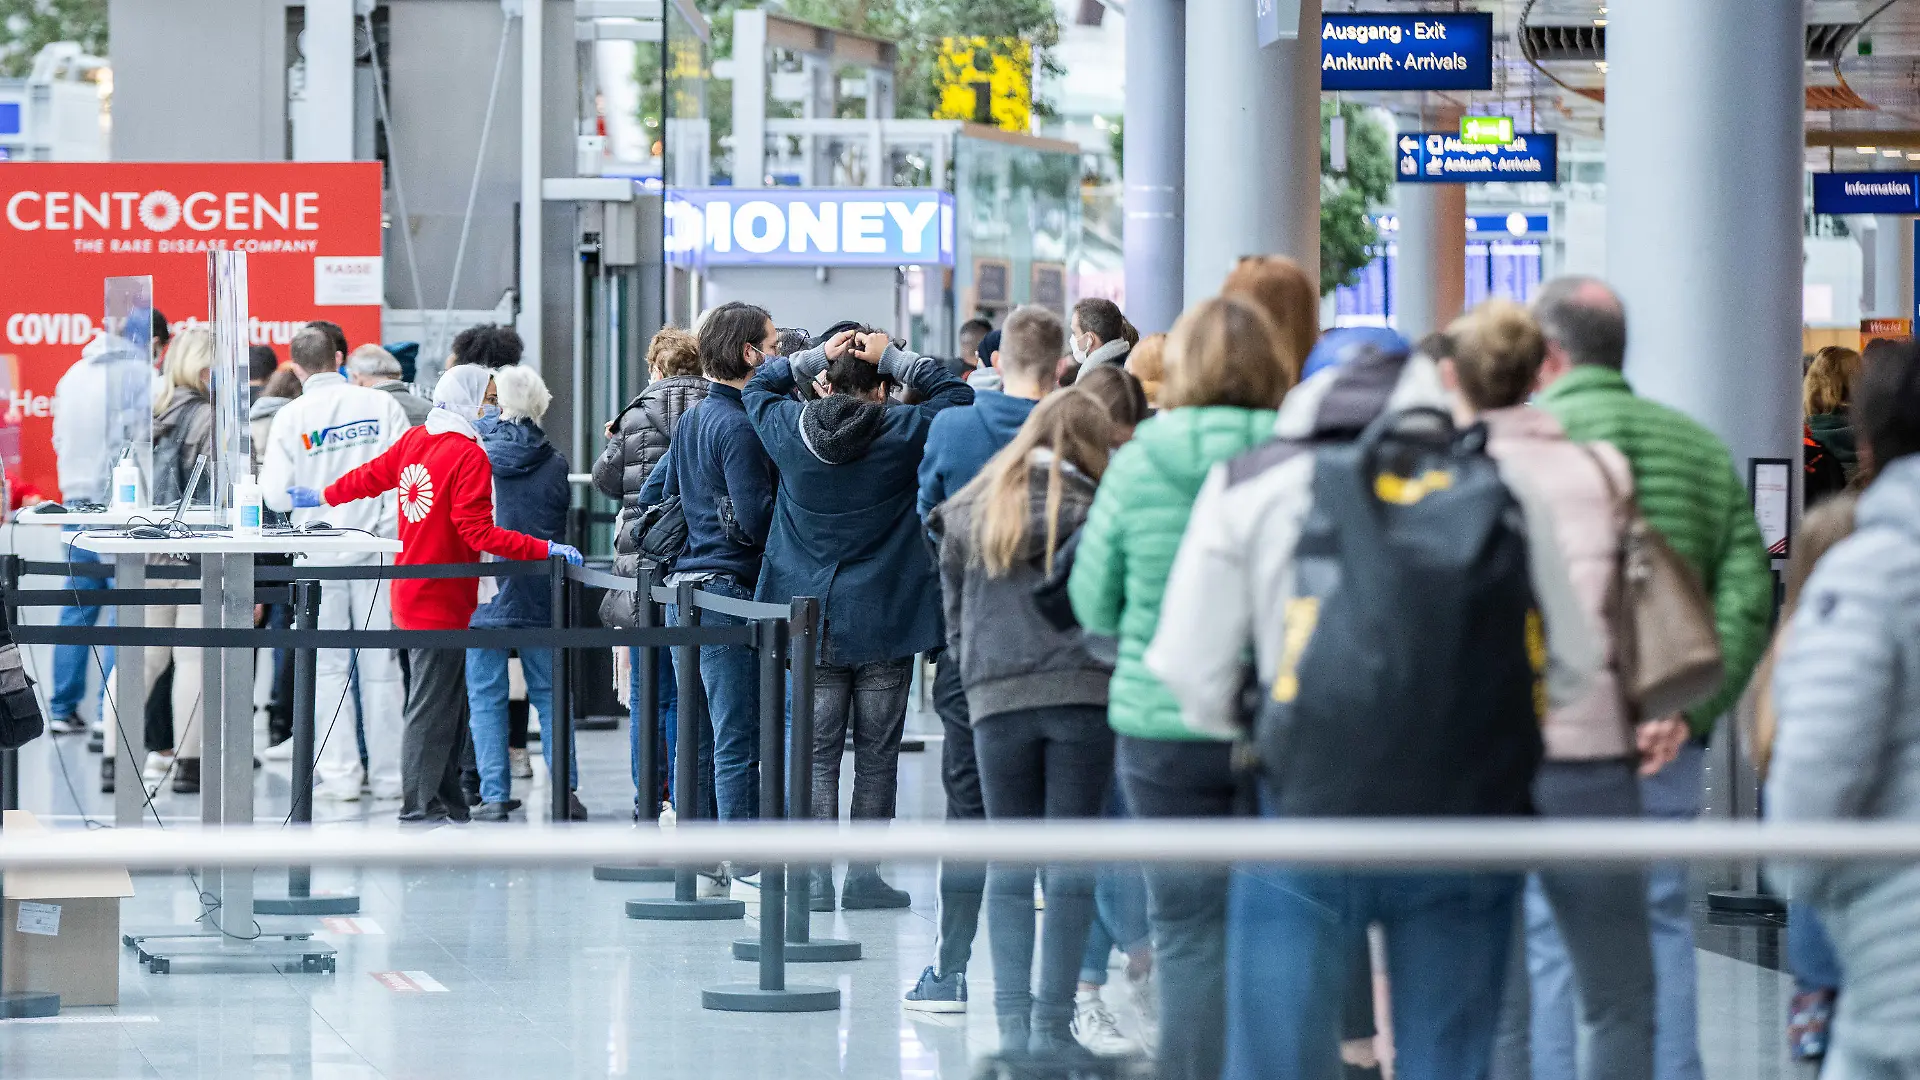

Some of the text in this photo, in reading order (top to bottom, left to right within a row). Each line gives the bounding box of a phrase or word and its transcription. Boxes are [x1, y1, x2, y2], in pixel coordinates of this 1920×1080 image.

[1322, 21, 1447, 44] Ausgang Exit
[1322, 51, 1468, 71] Ankunft Arrivals
[1443, 156, 1542, 172] Ankunft Arrivals
[1844, 180, 1911, 196] Information
[6, 190, 319, 231] CENTOGENE
[74, 239, 318, 253] THE RARE DISEASE COMPANY
